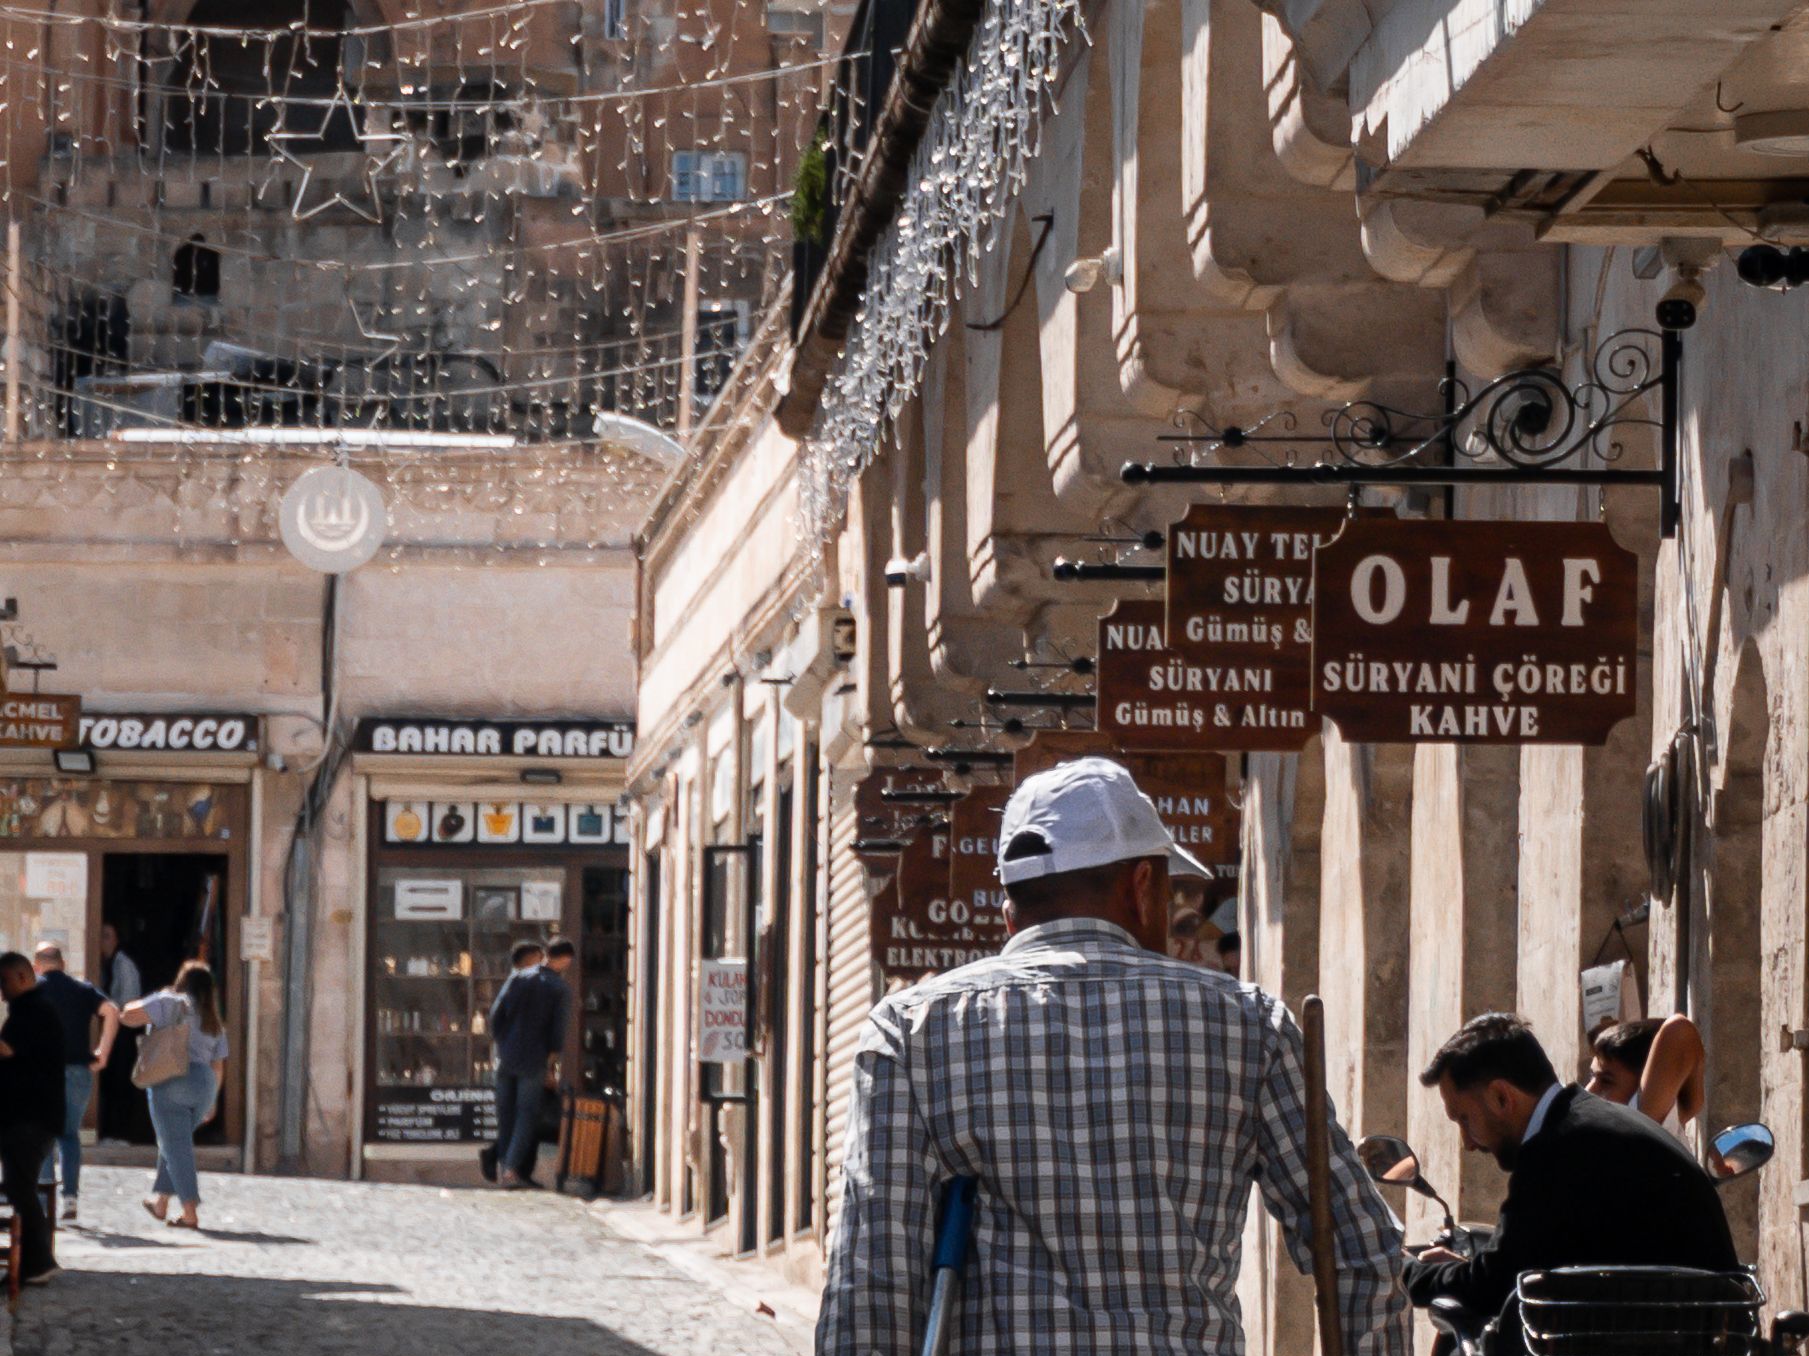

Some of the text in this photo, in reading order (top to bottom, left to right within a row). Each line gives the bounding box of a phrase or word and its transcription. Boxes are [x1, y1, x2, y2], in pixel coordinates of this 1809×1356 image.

[1177, 532, 1258, 560] NUAY
[1350, 554, 1601, 627] OLAF
[1186, 616, 1312, 650] Gümüş &
[1149, 658, 1272, 692] SÜRYANI
[1322, 653, 1626, 702] SÜRYANİ ÇÖREĞİ
[0, 702, 63, 720] CMEL
[1115, 701, 1304, 732] Gümüş & Altın
[1410, 705, 1539, 736] KAHVE
[0, 722, 62, 741] AHVE
[79, 717, 246, 750] TOBACCO
[372, 725, 500, 753] BAHAR
